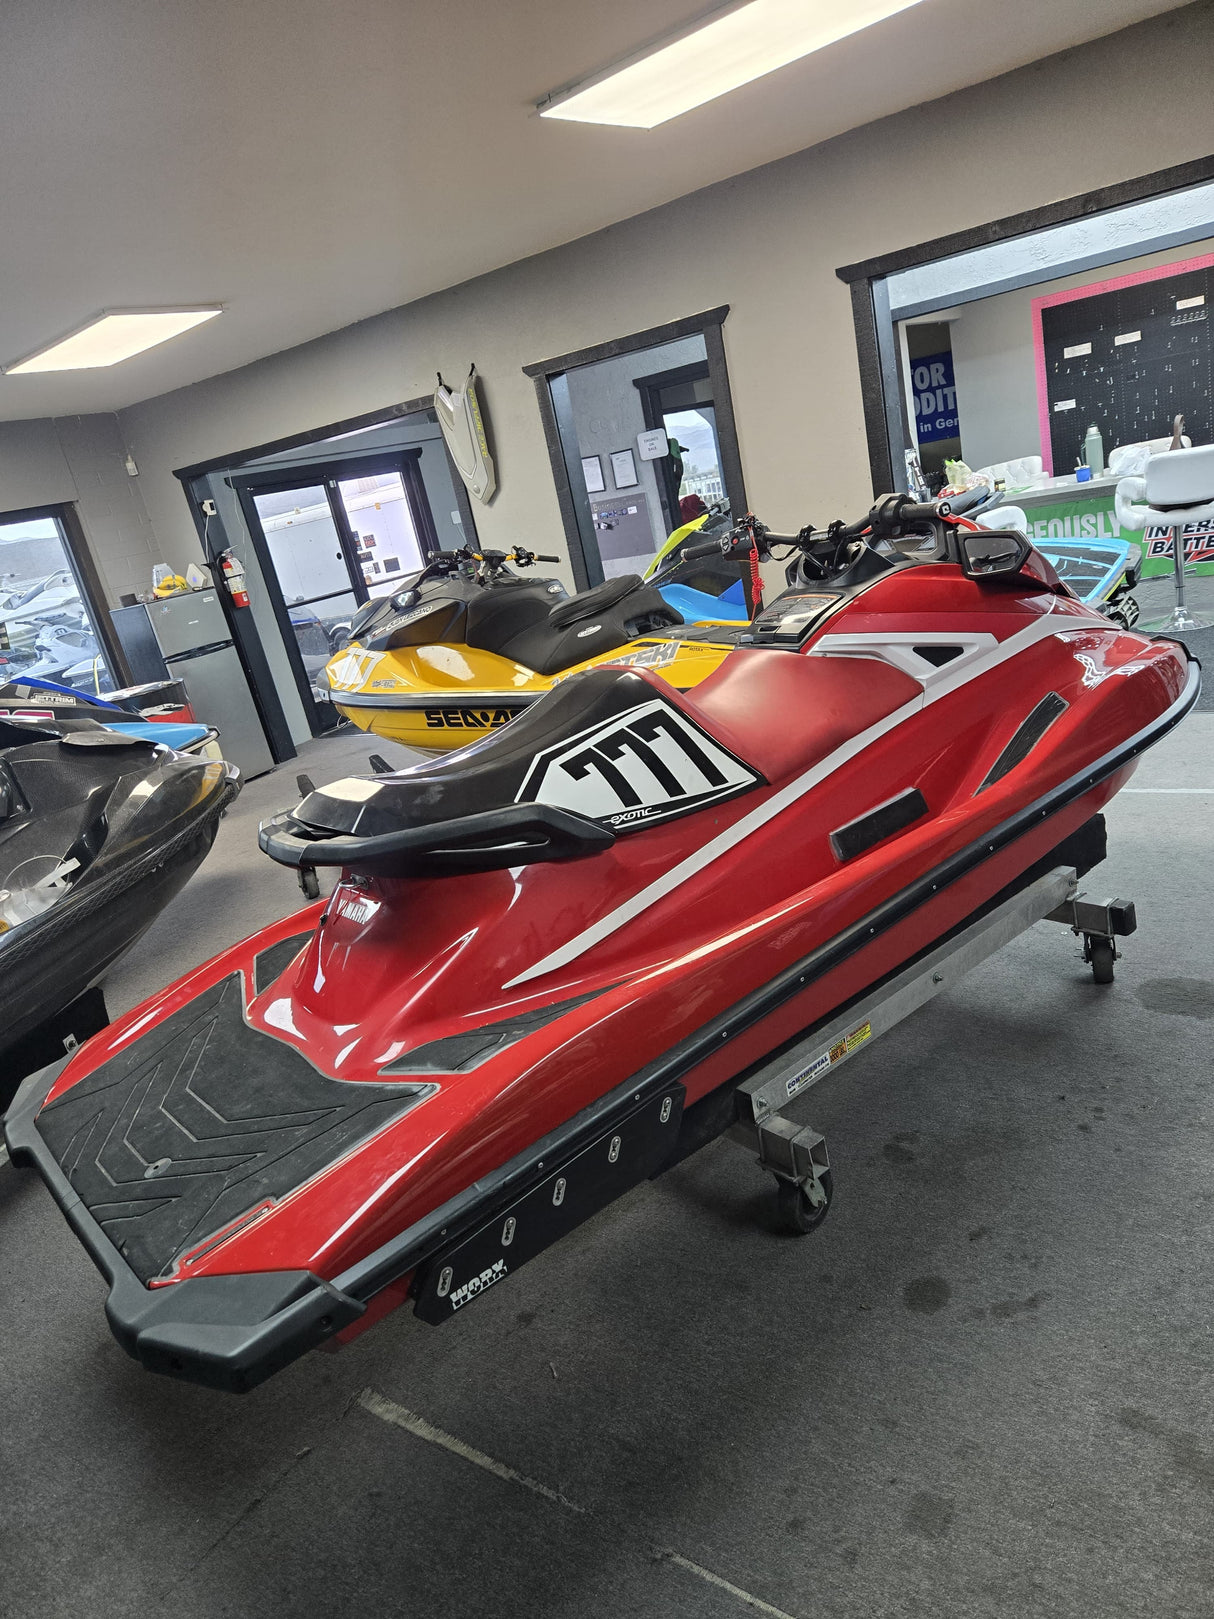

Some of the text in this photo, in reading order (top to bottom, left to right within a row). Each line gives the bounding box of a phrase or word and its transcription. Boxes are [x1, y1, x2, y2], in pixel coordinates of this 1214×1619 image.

[911, 363, 946, 390] OR
[920, 422, 932, 433] in
[1147, 520, 1214, 538] INER
[559, 709, 729, 808] 777
[336, 899, 365, 925] YAMAHA
[787, 1056, 828, 1089] CONTINENTAL
[449, 1258, 508, 1311] WORX
